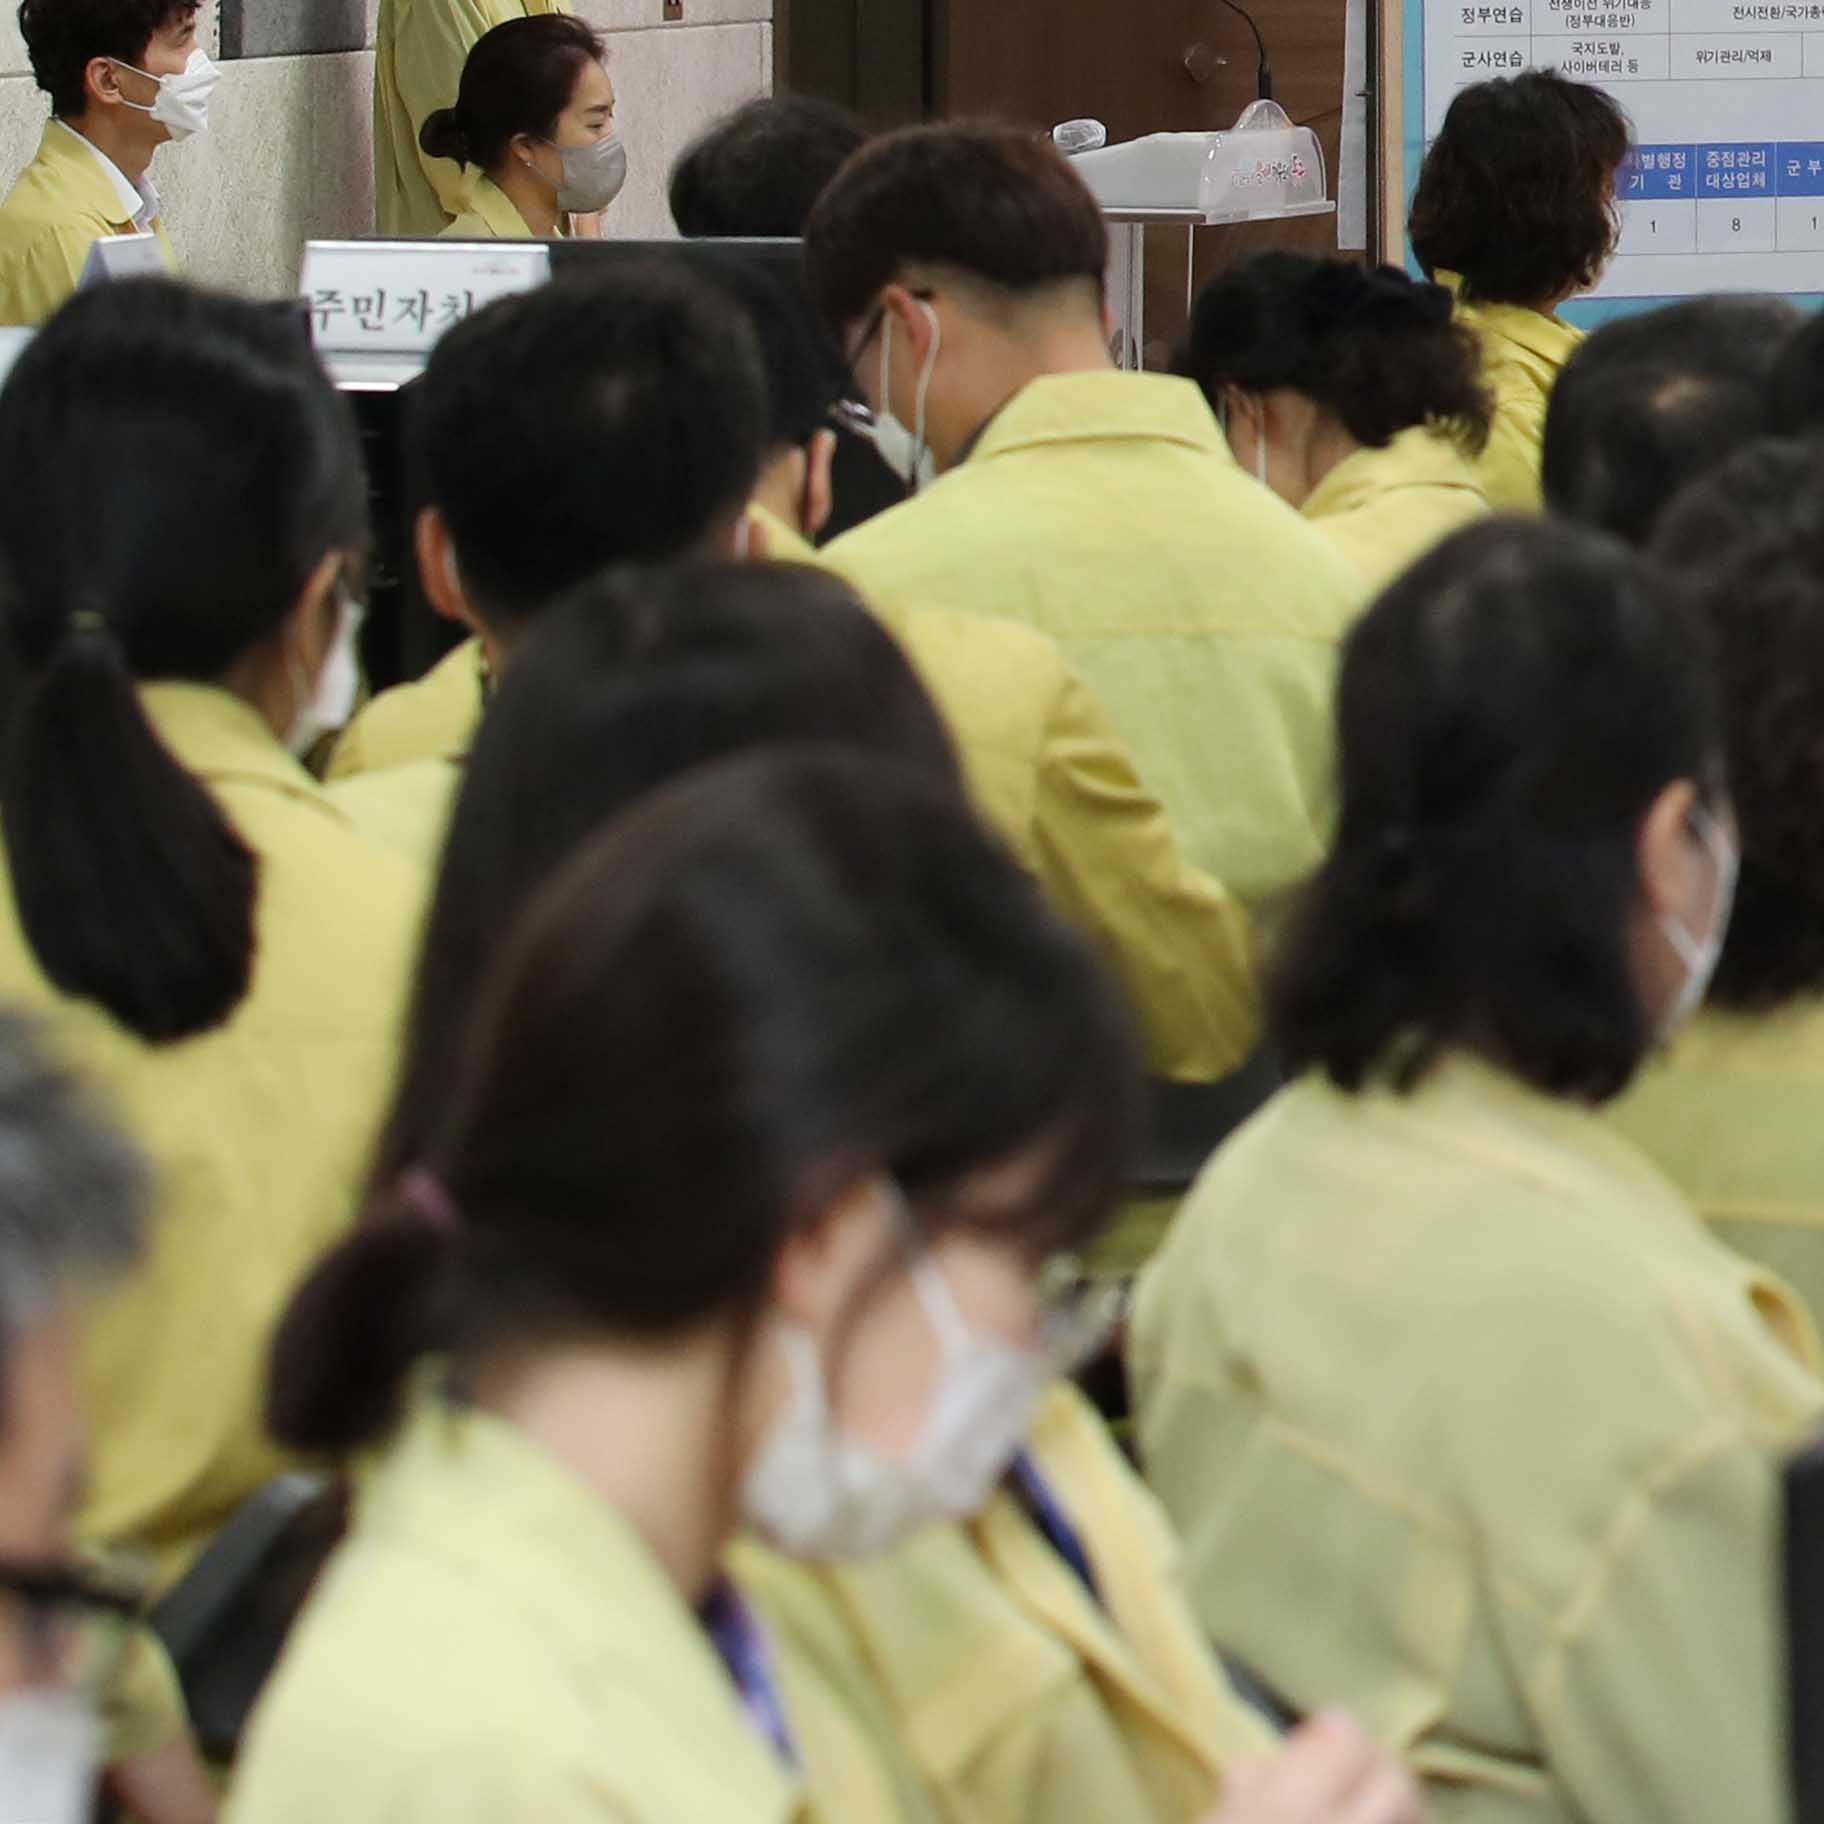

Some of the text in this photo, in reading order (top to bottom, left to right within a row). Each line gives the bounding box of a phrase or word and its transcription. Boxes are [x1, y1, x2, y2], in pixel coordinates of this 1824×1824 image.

[1461, 7, 1523, 25] 정부연습
[1461, 51, 1523, 68] 군사연습
[1635, 151, 1686, 169] 별행정
[1706, 150, 1766, 168] 중점관리
[1706, 171, 1767, 190] 대상업체
[1731, 218, 1741, 232] 8
[311, 288, 473, 333] 주민자치
